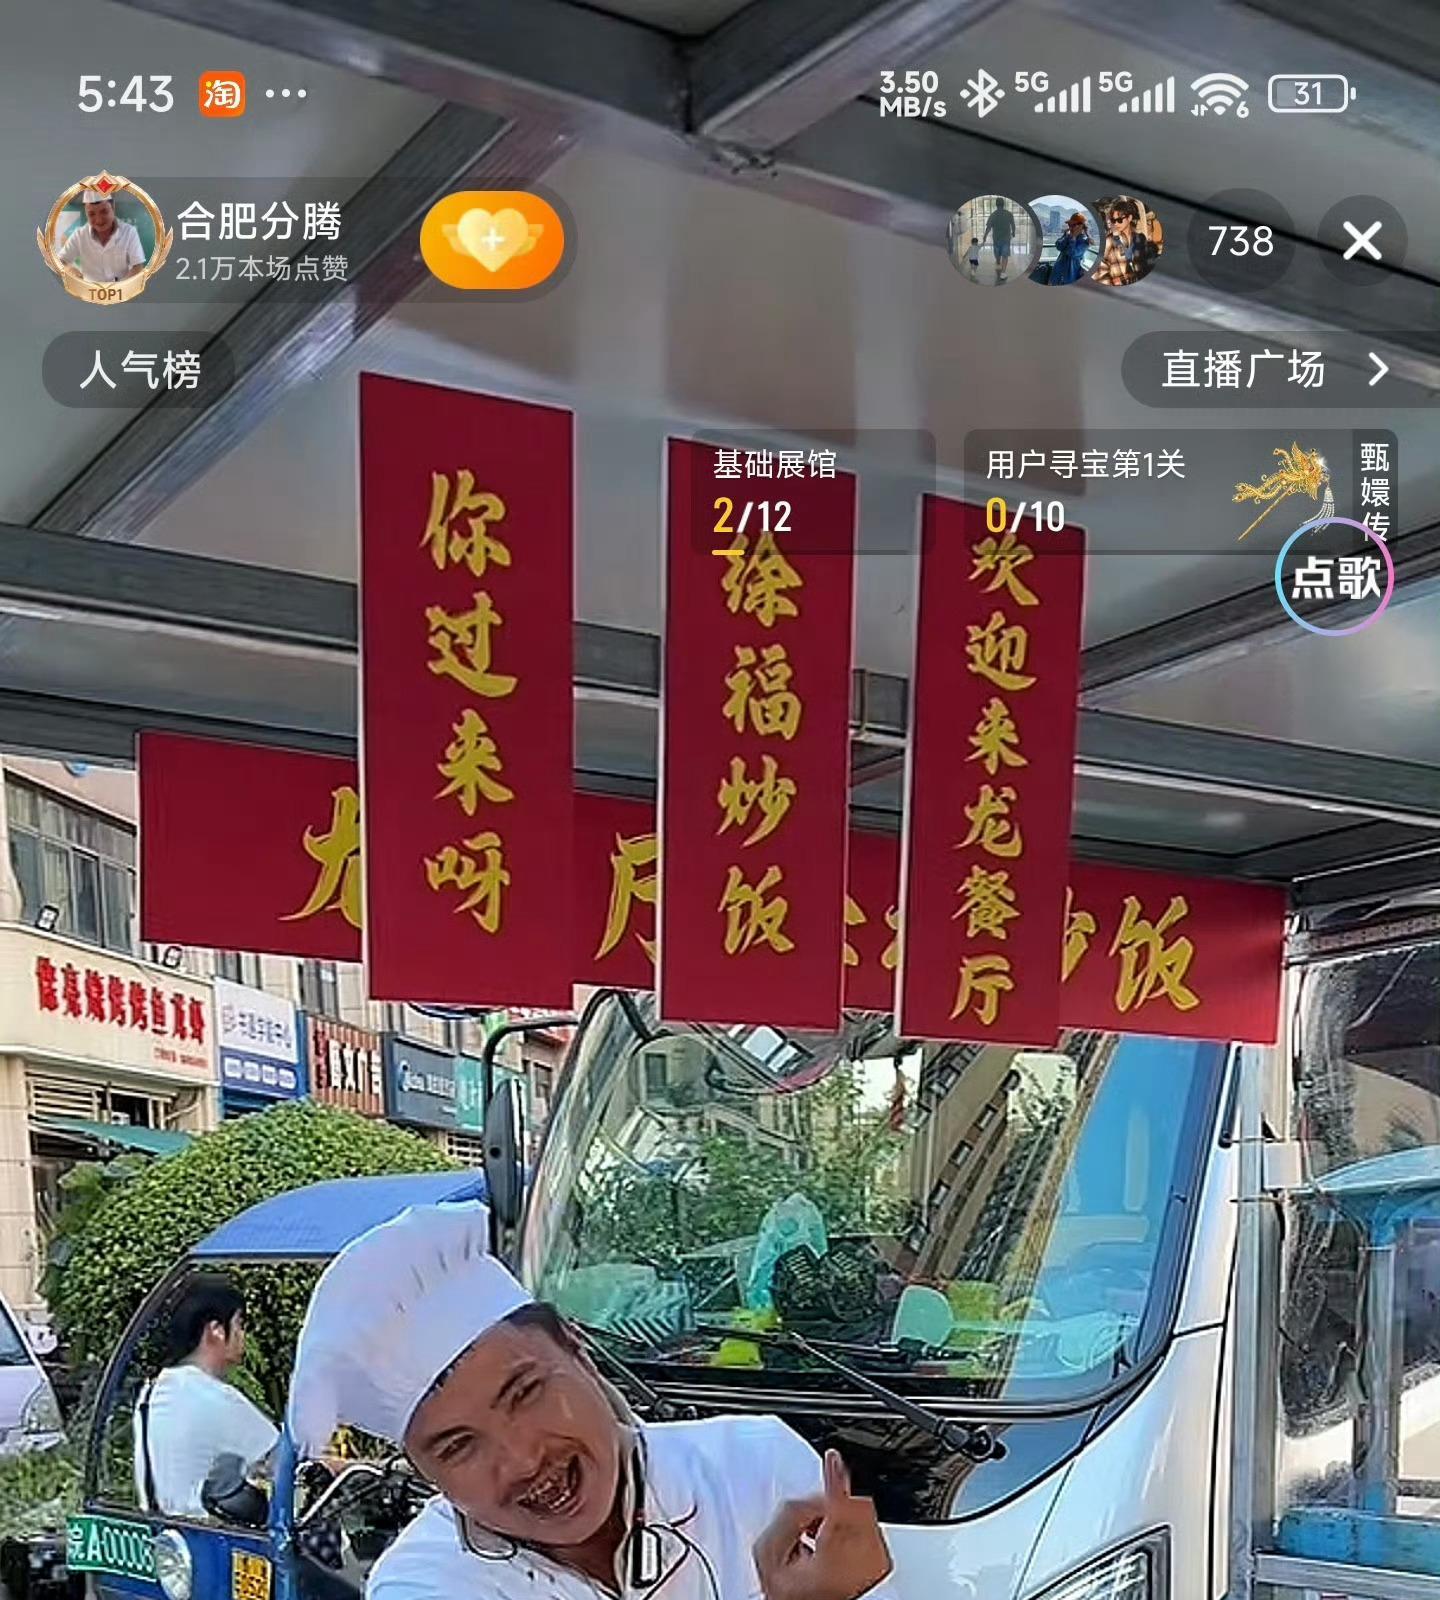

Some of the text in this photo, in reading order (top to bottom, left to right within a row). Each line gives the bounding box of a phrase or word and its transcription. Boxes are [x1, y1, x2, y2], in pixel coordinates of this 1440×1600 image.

[419, 469, 518, 935] 你过来呀
[713, 534, 803, 957] 徐福炒饭
[951, 535, 1040, 1026] 欢迎来龙餐厅
